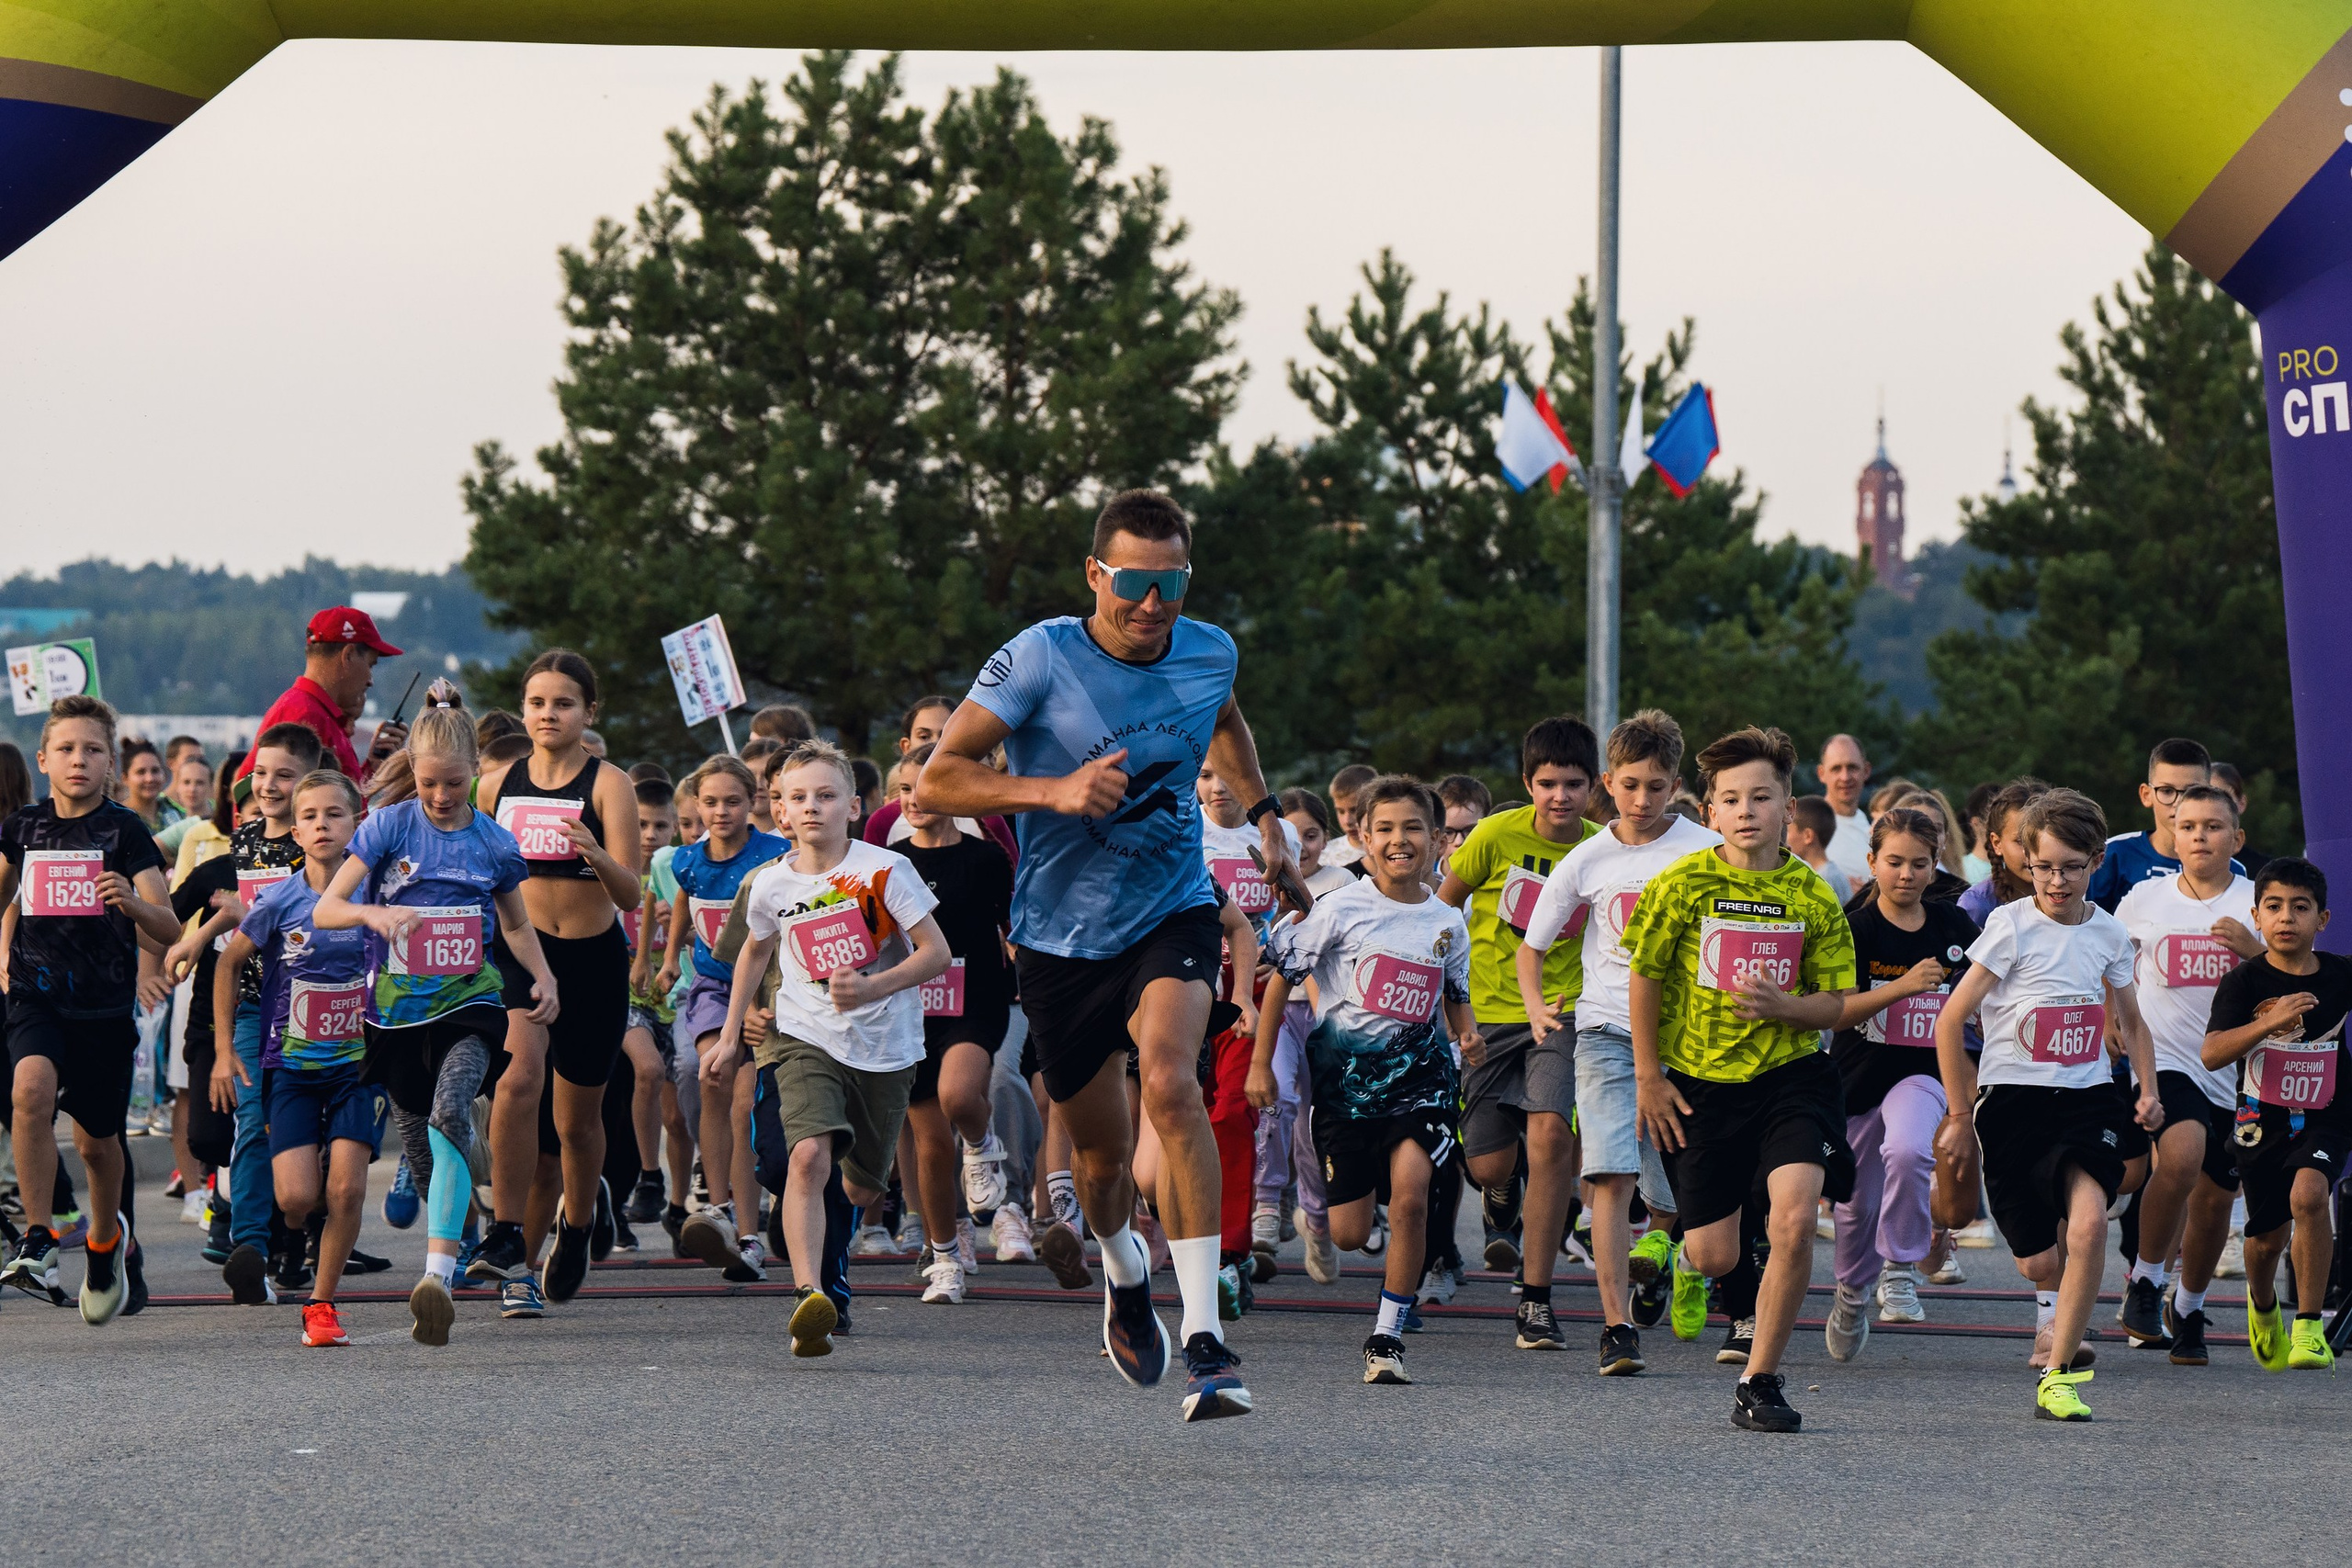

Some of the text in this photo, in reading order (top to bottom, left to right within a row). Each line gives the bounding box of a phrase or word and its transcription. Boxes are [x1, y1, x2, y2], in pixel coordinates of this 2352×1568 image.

[2278, 345, 2339, 383] PRO
[2283, 381, 2352, 438] СП
[1081, 720, 1150, 767] ОМАНДА
[519, 827, 570, 855] 2035
[1080, 814, 1142, 859] ОМАНДА
[48, 863, 88, 877] ЕВГЕНИЙ
[1236, 867, 1262, 879] СОФЬ
[45, 880, 96, 908] 1529
[1227, 881, 1271, 907] 4299
[1717, 901, 1782, 915] FREE NRG
[432, 922, 465, 935] МАРИЯ
[812, 921, 850, 942] НИКИТА
[423, 937, 477, 967] 1632
[811, 933, 867, 973] 3385
[1751, 942, 1778, 955] ГЛЕБ
[1396, 969, 1429, 988] ДАВИД
[2178, 953, 2232, 979] 3465
[331, 994, 362, 1010] СЕРГЕЙ
[1377, 982, 1430, 1017] 3203
[1907, 997, 1941, 1010] УЛЬЯНА
[318, 1011, 363, 1037] 324
[1902, 1011, 1938, 1039] 167
[2064, 1010, 2085, 1025] ОЛЕГ
[2046, 1025, 2097, 1056] 4667
[2283, 1059, 2324, 1073] АРСЕНИЙ
[2279, 1075, 2324, 1103] 907
